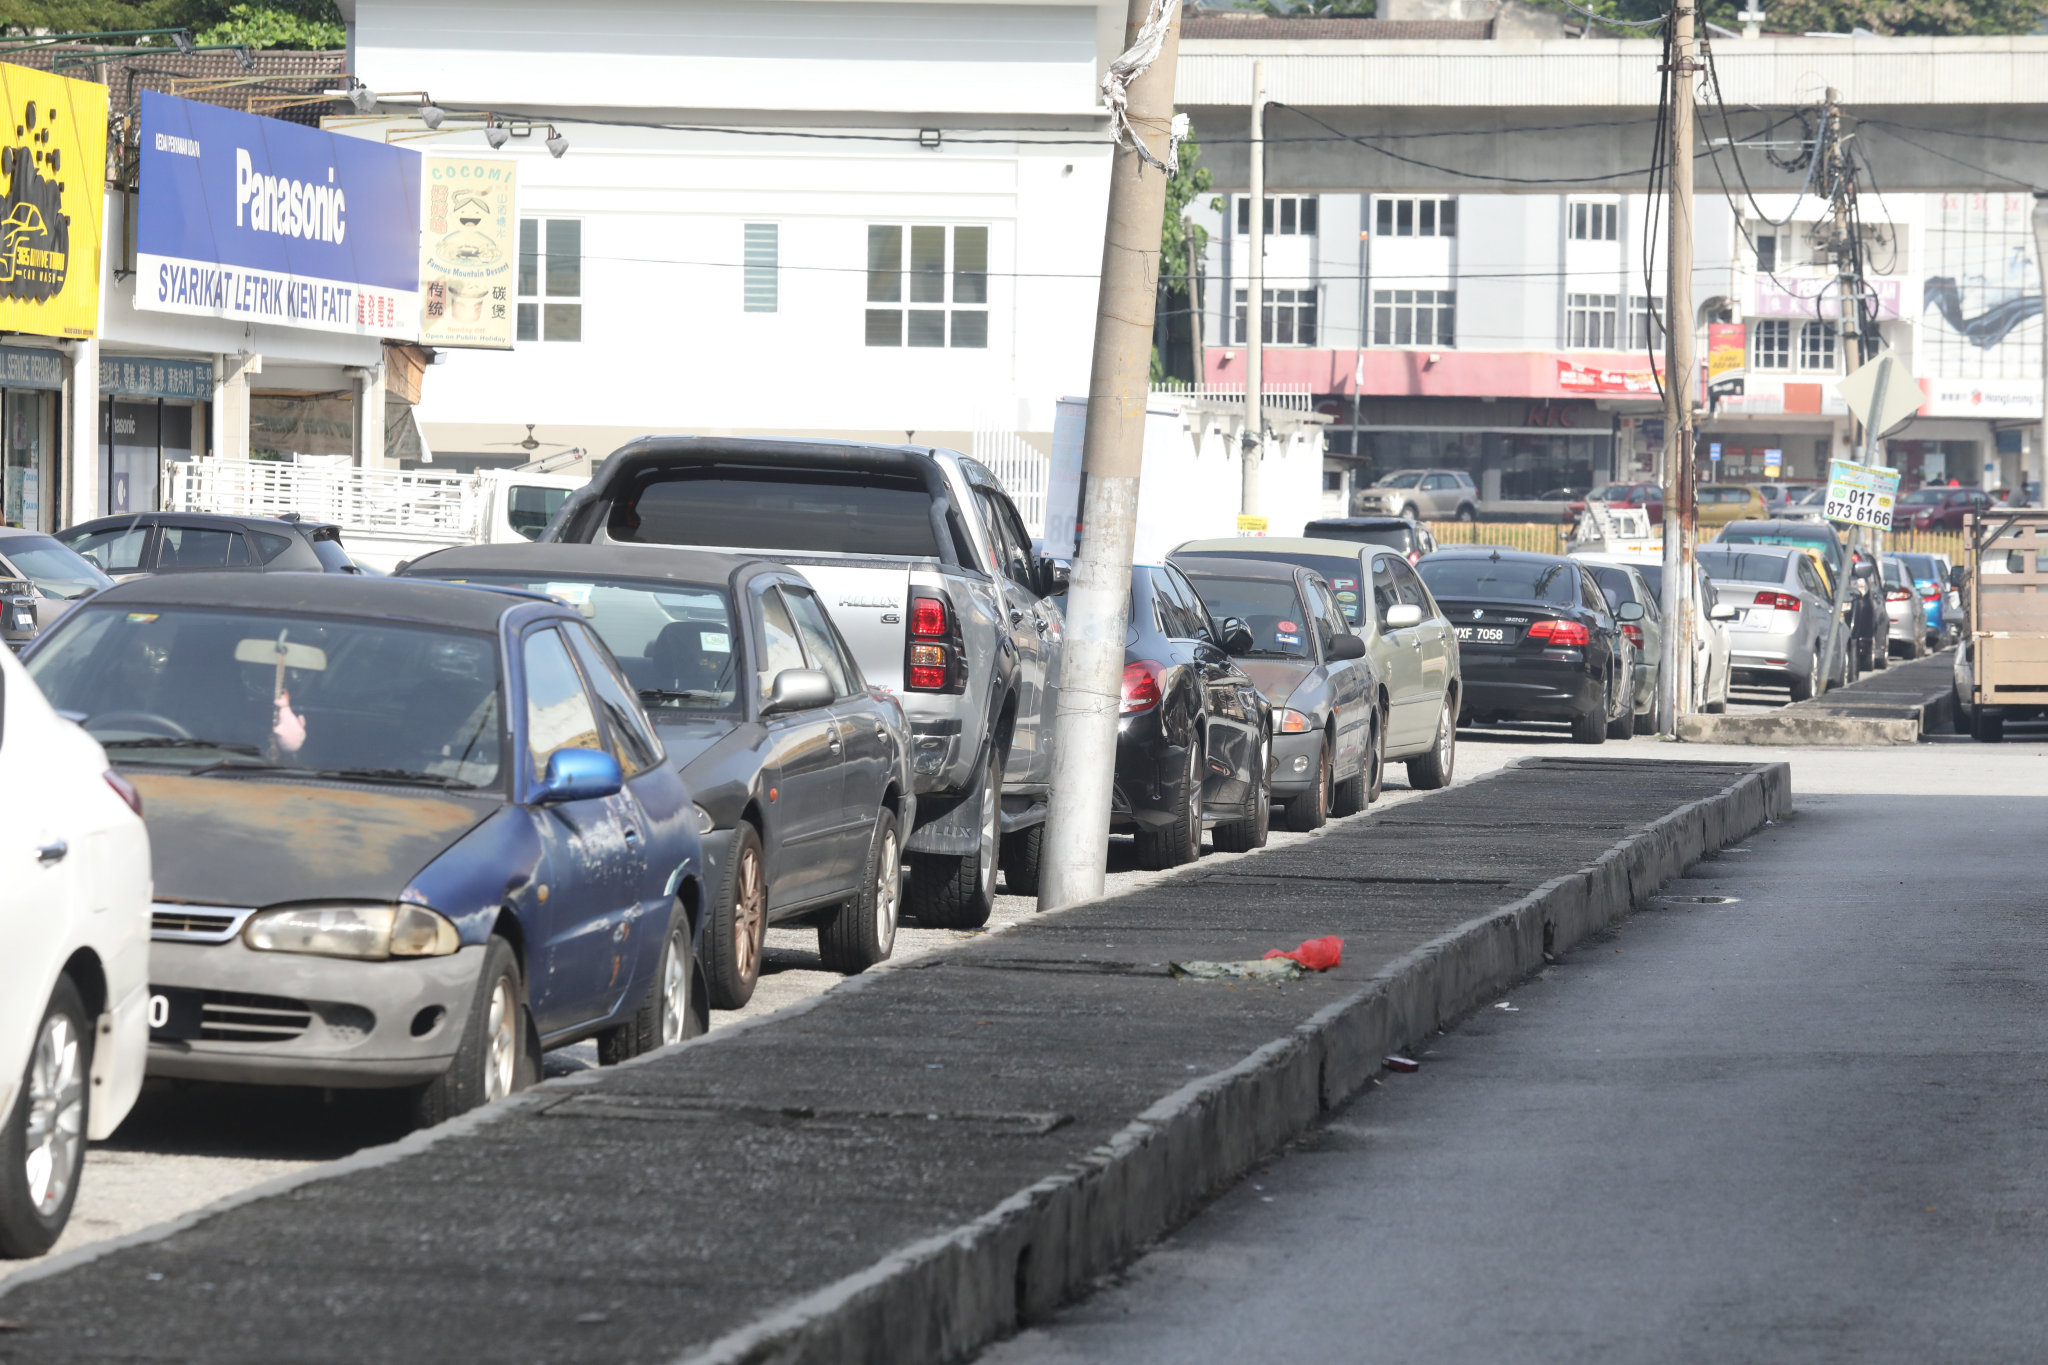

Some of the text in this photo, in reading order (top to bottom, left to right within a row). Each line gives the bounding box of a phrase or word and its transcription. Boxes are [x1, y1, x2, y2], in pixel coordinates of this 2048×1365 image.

[432, 165, 512, 183] COCOMI
[236, 147, 345, 245] Panasonic
[24, 269, 56, 283] CAR WASH
[427, 258, 509, 278] Famous Mountain Dessert
[159, 263, 352, 324] SYARIKAT LETRIK KIEN FATT
[428, 282, 444, 316] 传统
[492, 286, 506, 320] 碳煲
[8, 353, 30, 380] SERVICE
[105, 412, 136, 435] Pnasonic
[1528, 406, 1577, 427] KFC
[1849, 490, 1875, 507] 017
[1827, 501, 1891, 526] 873 6166
[1476, 628, 1504, 640] 7058
